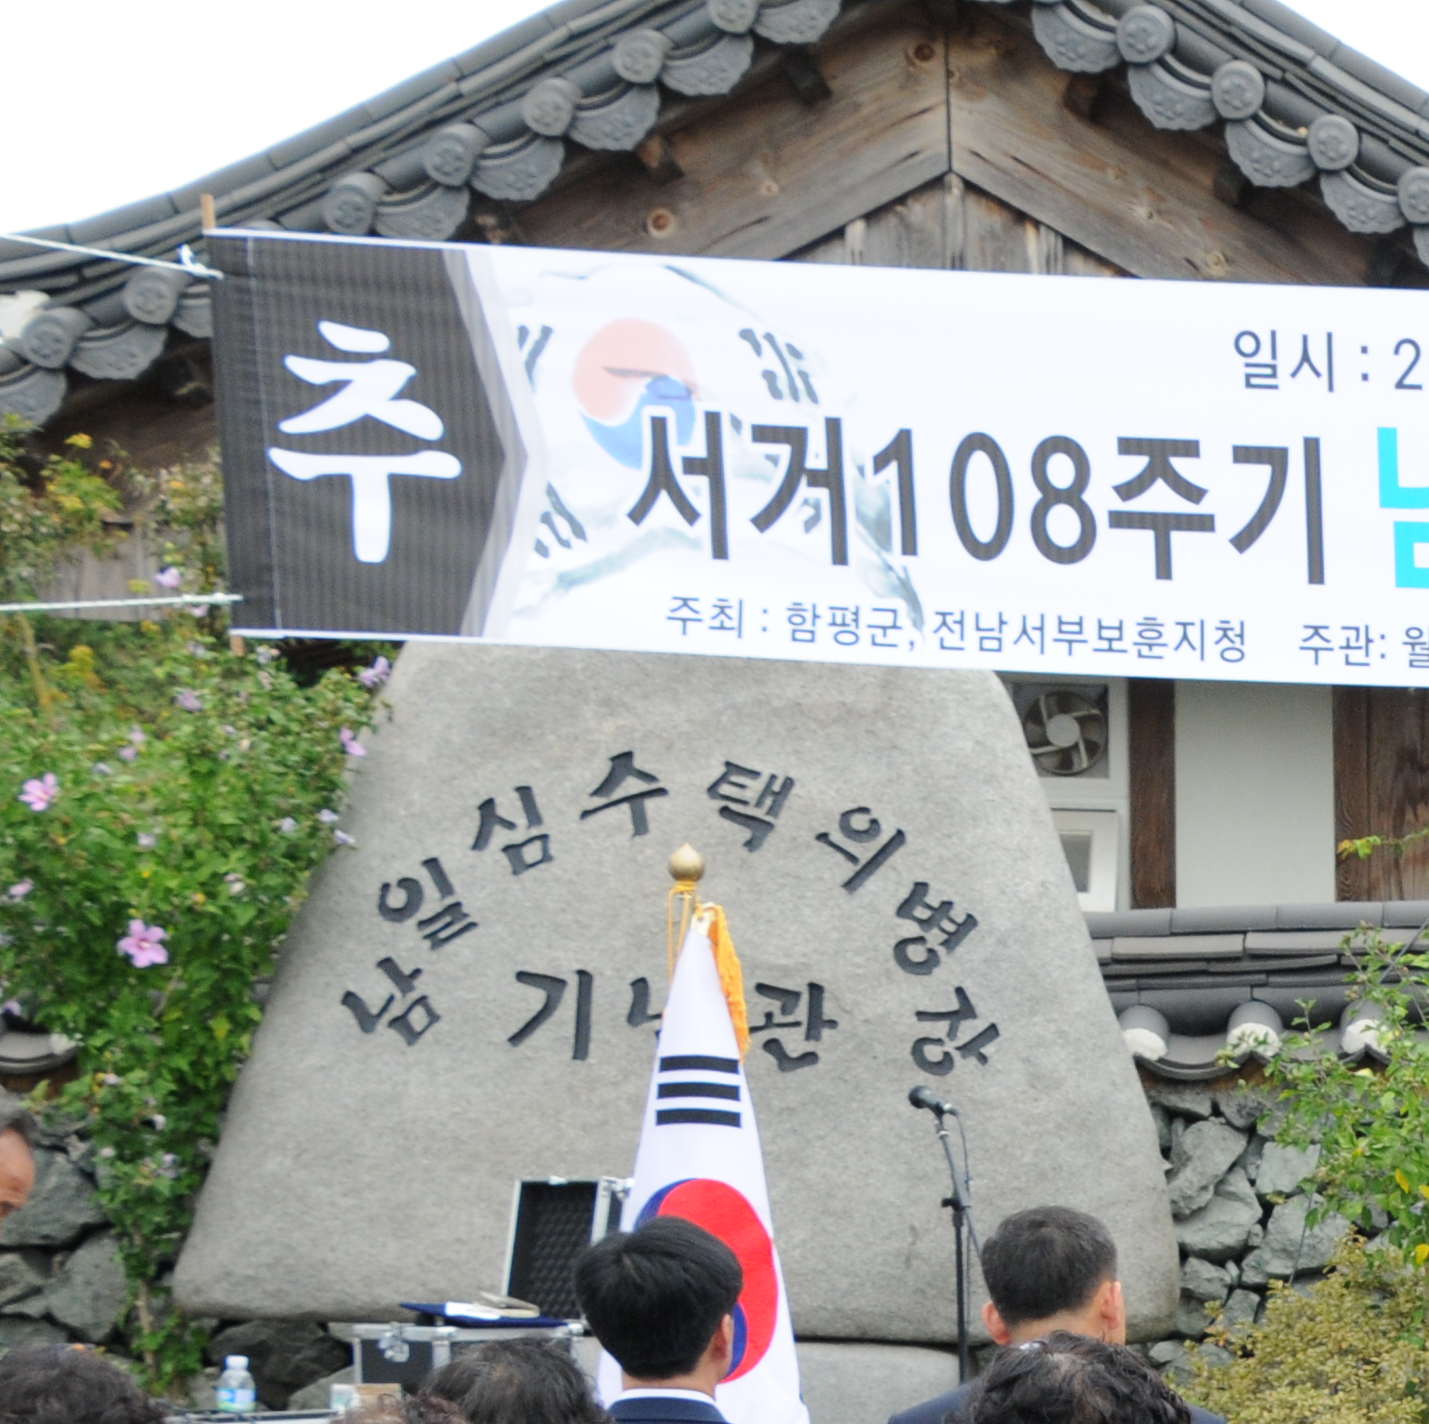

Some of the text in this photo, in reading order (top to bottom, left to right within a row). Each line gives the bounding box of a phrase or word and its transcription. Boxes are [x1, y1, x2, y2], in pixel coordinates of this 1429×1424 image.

[1232, 329, 1337, 393] 일시
[268, 319, 462, 564] 추
[628, 411, 1326, 584] 서거108주기
[666, 595, 745, 640] 주최
[784, 601, 916, 654] 함평군,
[932, 610, 1247, 663] 전남서부보훈지청
